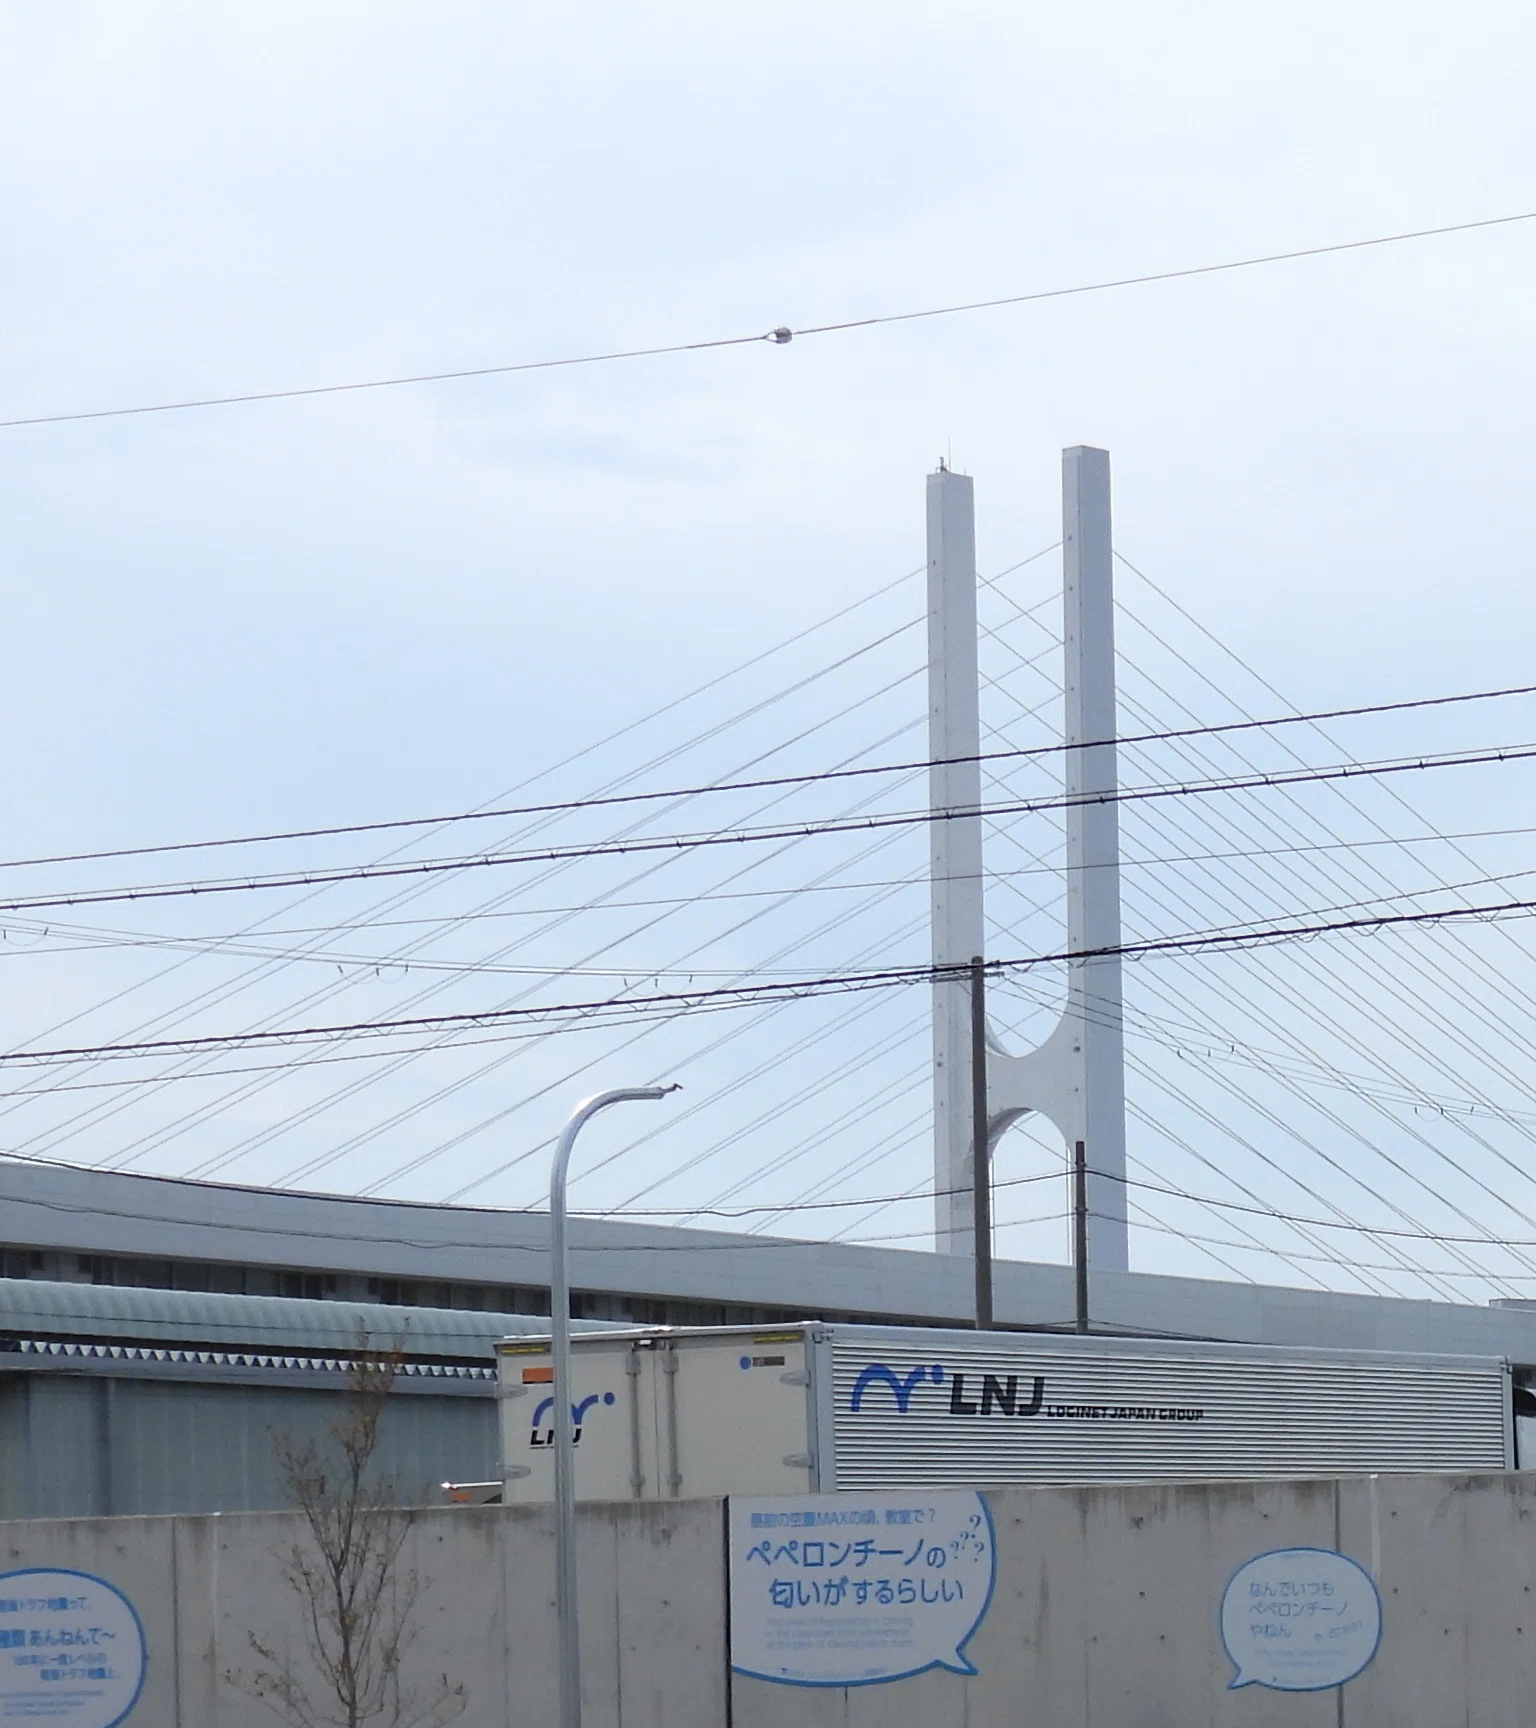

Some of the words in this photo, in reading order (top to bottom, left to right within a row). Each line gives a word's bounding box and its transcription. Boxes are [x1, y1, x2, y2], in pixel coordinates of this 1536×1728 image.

[949, 1372, 1046, 1416] LNJ
[1159, 1408, 1204, 1421] GROUP
[746, 1538, 946, 1568] ペペロンチーノの
[769, 1576, 964, 1608] 匂いがするらしい
[1249, 1582, 1335, 1597] なんでいつも
[1250, 1601, 1348, 1617] ペペロンチーノ
[1250, 1623, 1292, 1639] やねん
